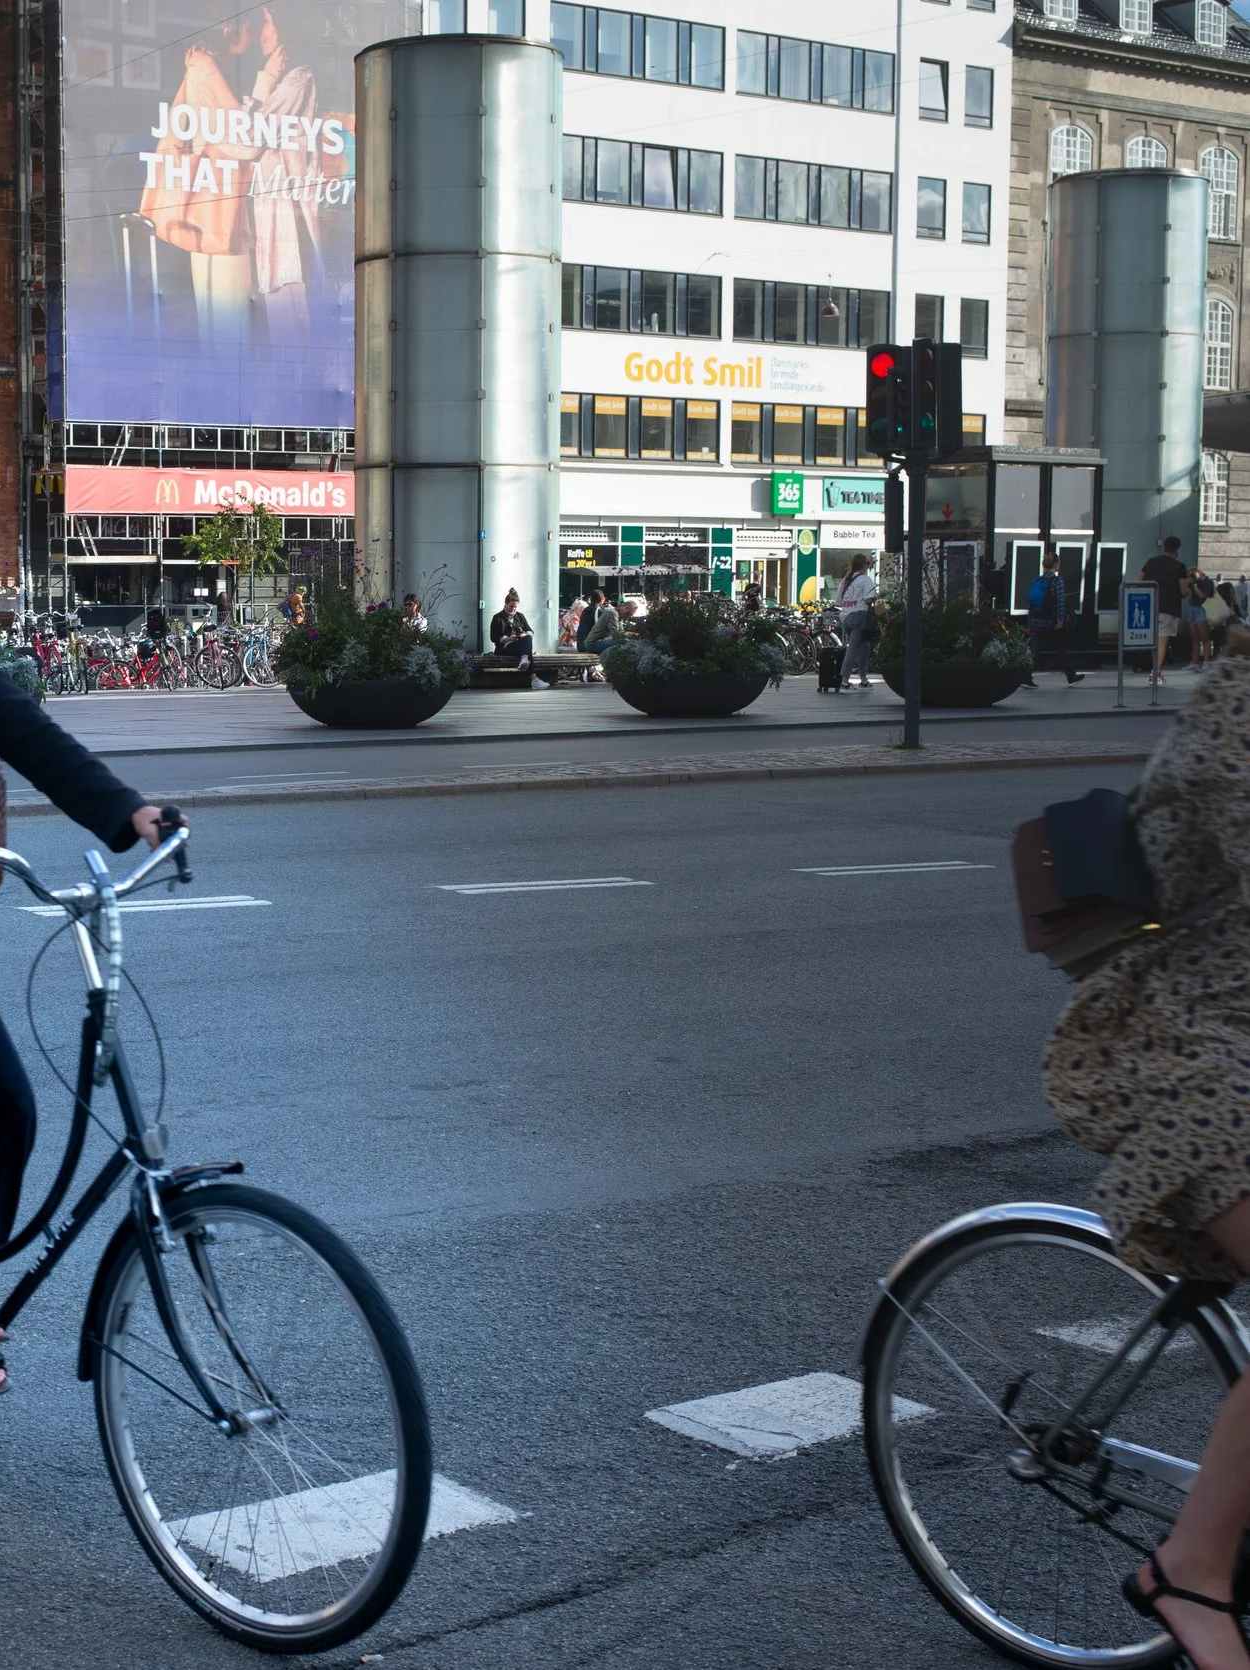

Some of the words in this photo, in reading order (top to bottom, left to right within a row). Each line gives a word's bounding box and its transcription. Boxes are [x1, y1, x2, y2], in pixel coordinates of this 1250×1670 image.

[151, 101, 345, 155] JOURNEYS
[139, 152, 239, 195] THAT
[624, 351, 694, 385] Godt
[703, 356, 762, 389] Smil
[194, 480, 346, 508] McDonald's
[777, 483, 800, 501] 365
[841, 491, 861, 504] TEA
[833, 530, 859, 539] Bubble
[861, 530, 876, 539] Tea
[567, 548, 585, 558] Kaffe
[585, 548, 593, 558] til
[1130, 631, 1148, 641] Zone
